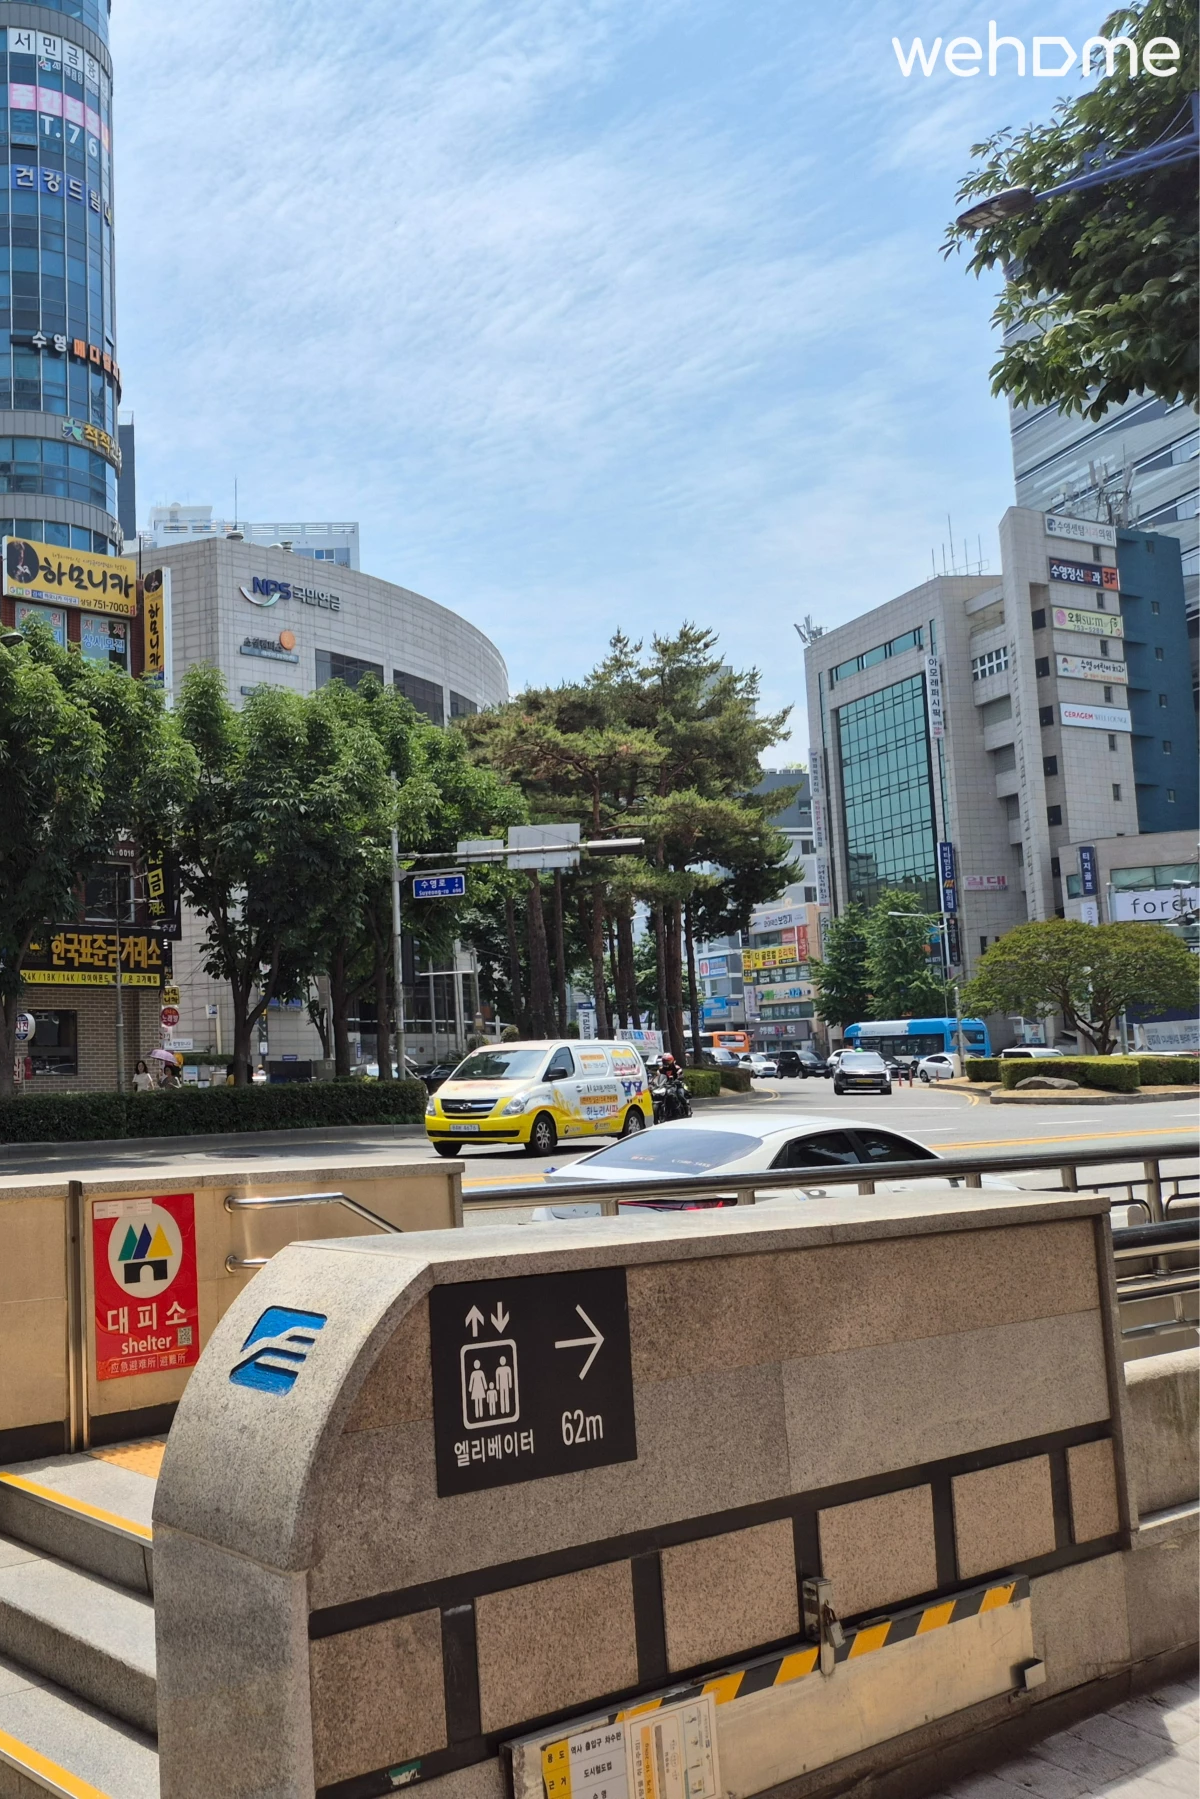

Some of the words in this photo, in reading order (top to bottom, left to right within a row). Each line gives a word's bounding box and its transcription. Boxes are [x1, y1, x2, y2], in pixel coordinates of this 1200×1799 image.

[39, 557, 134, 598] 하모니카
[253, 577, 291, 600] NPS
[1103, 571, 1116, 585] 3F
[93, 598, 129, 613] 751-7003
[293, 585, 341, 611] 국민연금
[84, 620, 125, 638] 지도자
[148, 603, 160, 666] 하모니카
[83, 634, 125, 653] 상시모집
[928, 658, 942, 718] 아모레퍼시픽
[1064, 710, 1093, 720] CERAGEM
[150, 872, 161, 893] 금
[421, 879, 446, 889] 수영로
[966, 876, 1006, 886] 임대
[51, 932, 162, 969] 한국표준금거래소
[107, 1301, 188, 1335] 대피소
[121, 1335, 173, 1355] shelter
[561, 1408, 604, 1446] 62m
[453, 1429, 535, 1468] 엘리베이터
[570, 1745, 583, 1755] 역사
[585, 1739, 602, 1752] 출입구
[604, 1732, 622, 1745] 차수판
[583, 1761, 612, 1778] 도시철도법
